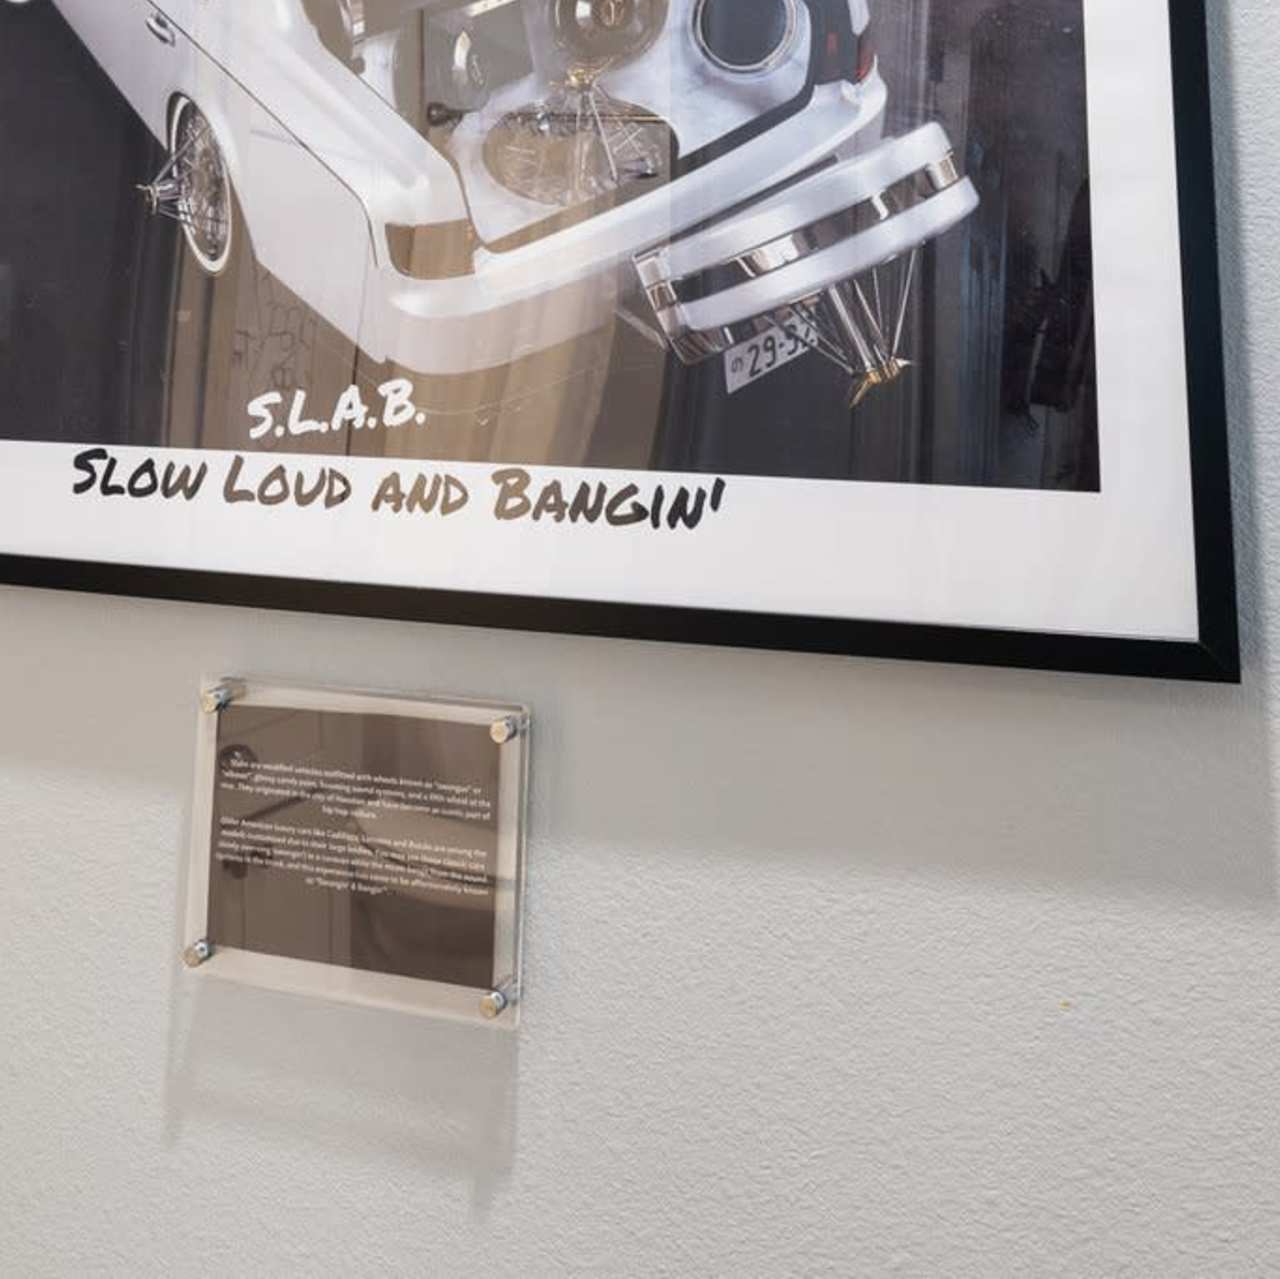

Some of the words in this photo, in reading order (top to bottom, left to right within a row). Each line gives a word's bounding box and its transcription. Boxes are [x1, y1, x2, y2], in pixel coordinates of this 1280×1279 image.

[247, 378, 426, 440] S.L.A.B.
[73, 448, 209, 501] SLOW
[223, 454, 352, 508] LOUD
[371, 468, 469, 519] AND
[492, 466, 726, 531] BANGIN'
